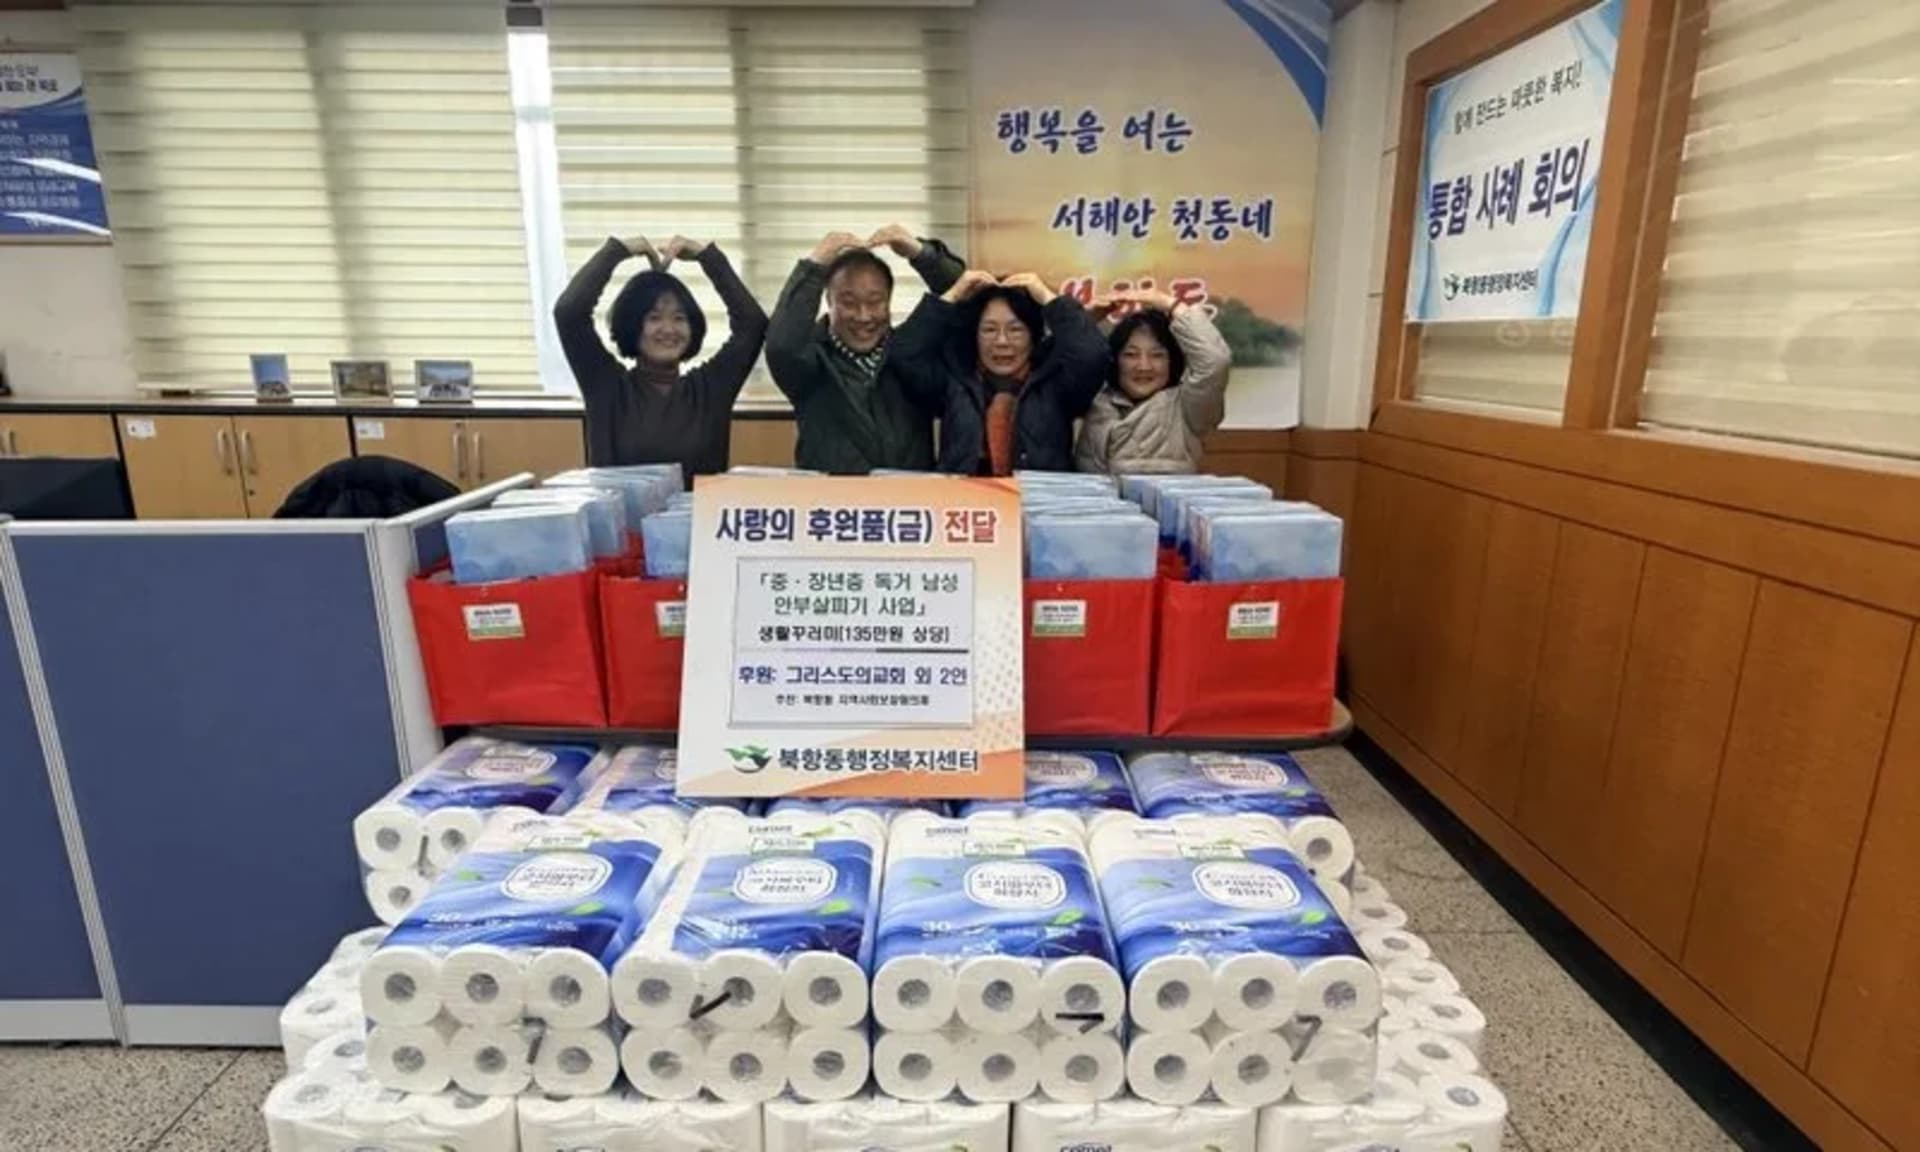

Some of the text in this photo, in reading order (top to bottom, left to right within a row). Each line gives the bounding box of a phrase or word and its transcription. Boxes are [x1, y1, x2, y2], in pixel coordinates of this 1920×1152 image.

[1511, 76, 1547, 110] 따뜻한
[1551, 61, 1583, 95] 복지!
[998, 110, 1192, 154] 행복을 여는
[1428, 138, 1590, 240] 통합 사례 회의
[1053, 197, 1273, 240] 서해안 첫동네
[716, 509, 997, 543] 사랑의 후원품(금) 전달
[874, 572, 911, 592] 독거
[922, 572, 958, 592] 남성
[774, 596, 926, 617] 안부살피기 사업」
[738, 665, 967, 686] 후원: 그리스도의교회 외 2인
[778, 748, 978, 772] 북항동행정복지센터
